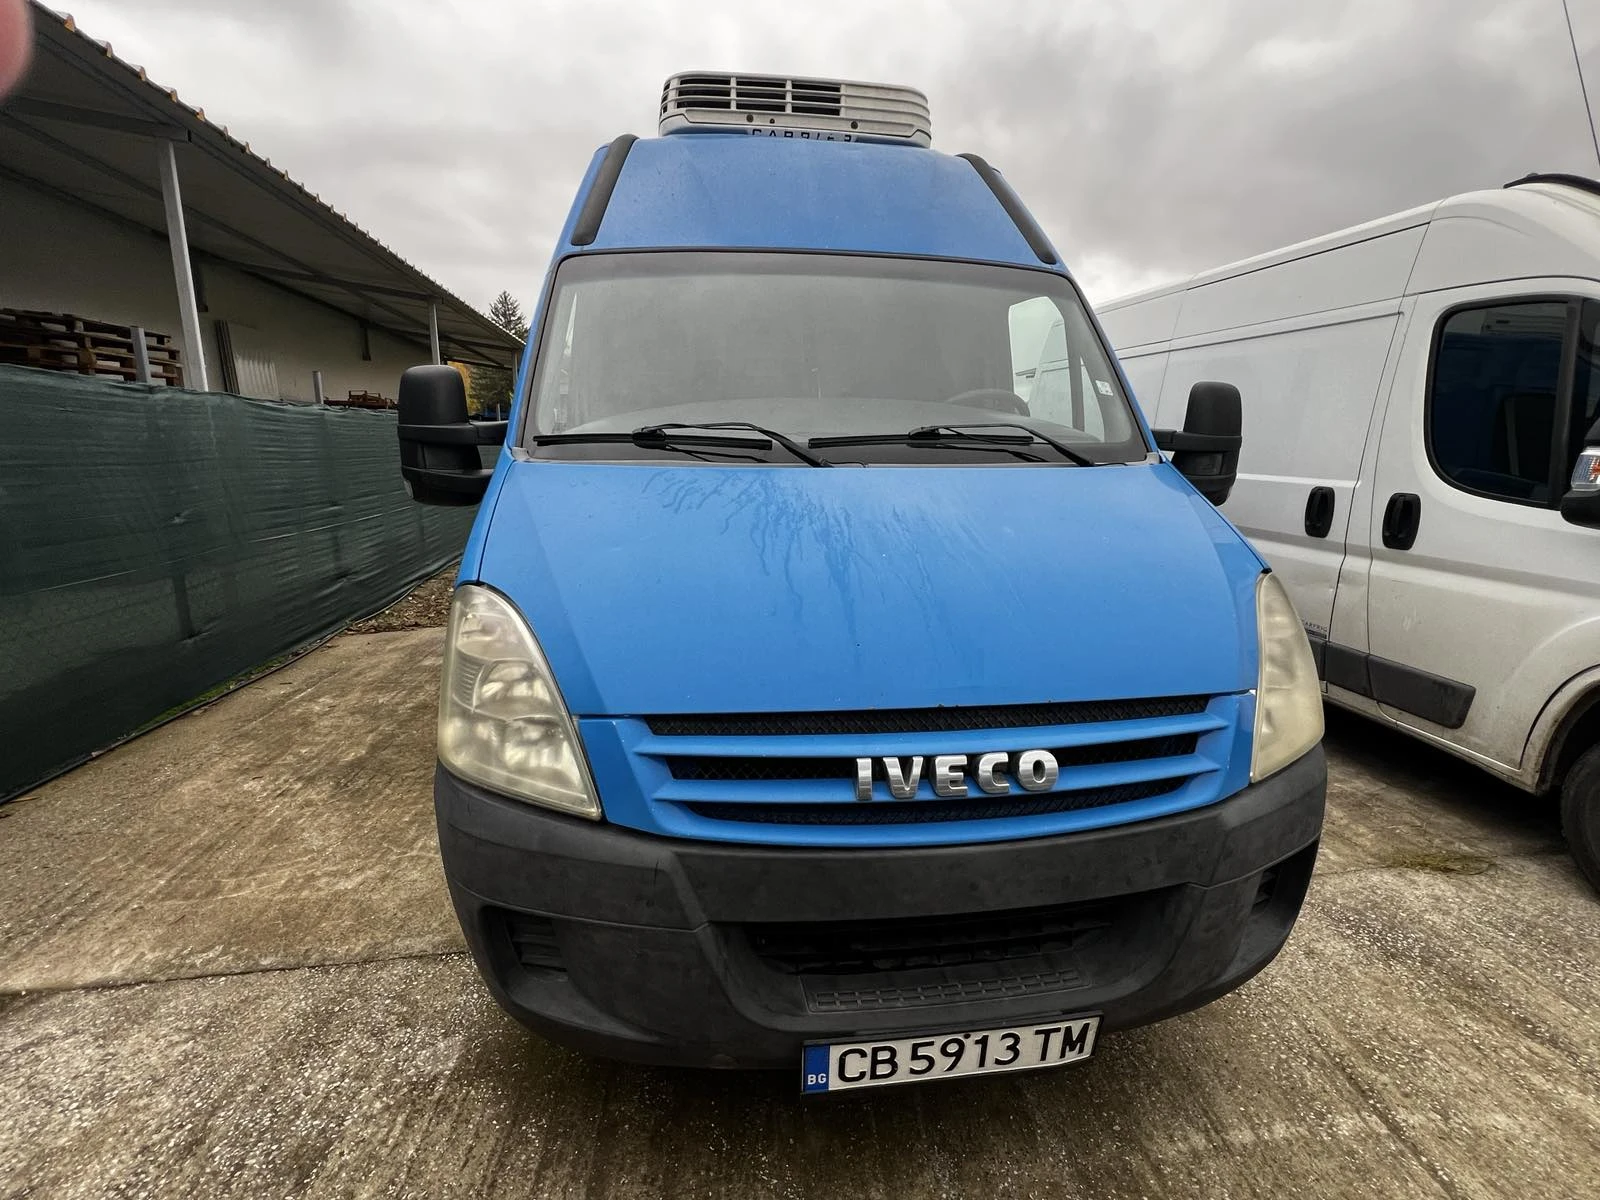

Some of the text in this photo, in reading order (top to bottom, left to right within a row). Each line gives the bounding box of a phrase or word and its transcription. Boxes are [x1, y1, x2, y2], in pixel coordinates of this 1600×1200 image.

[855, 749, 1059, 800] IVECO
[837, 1022, 1091, 1082] CB 5913 TM
[807, 1074, 827, 1085] BG
